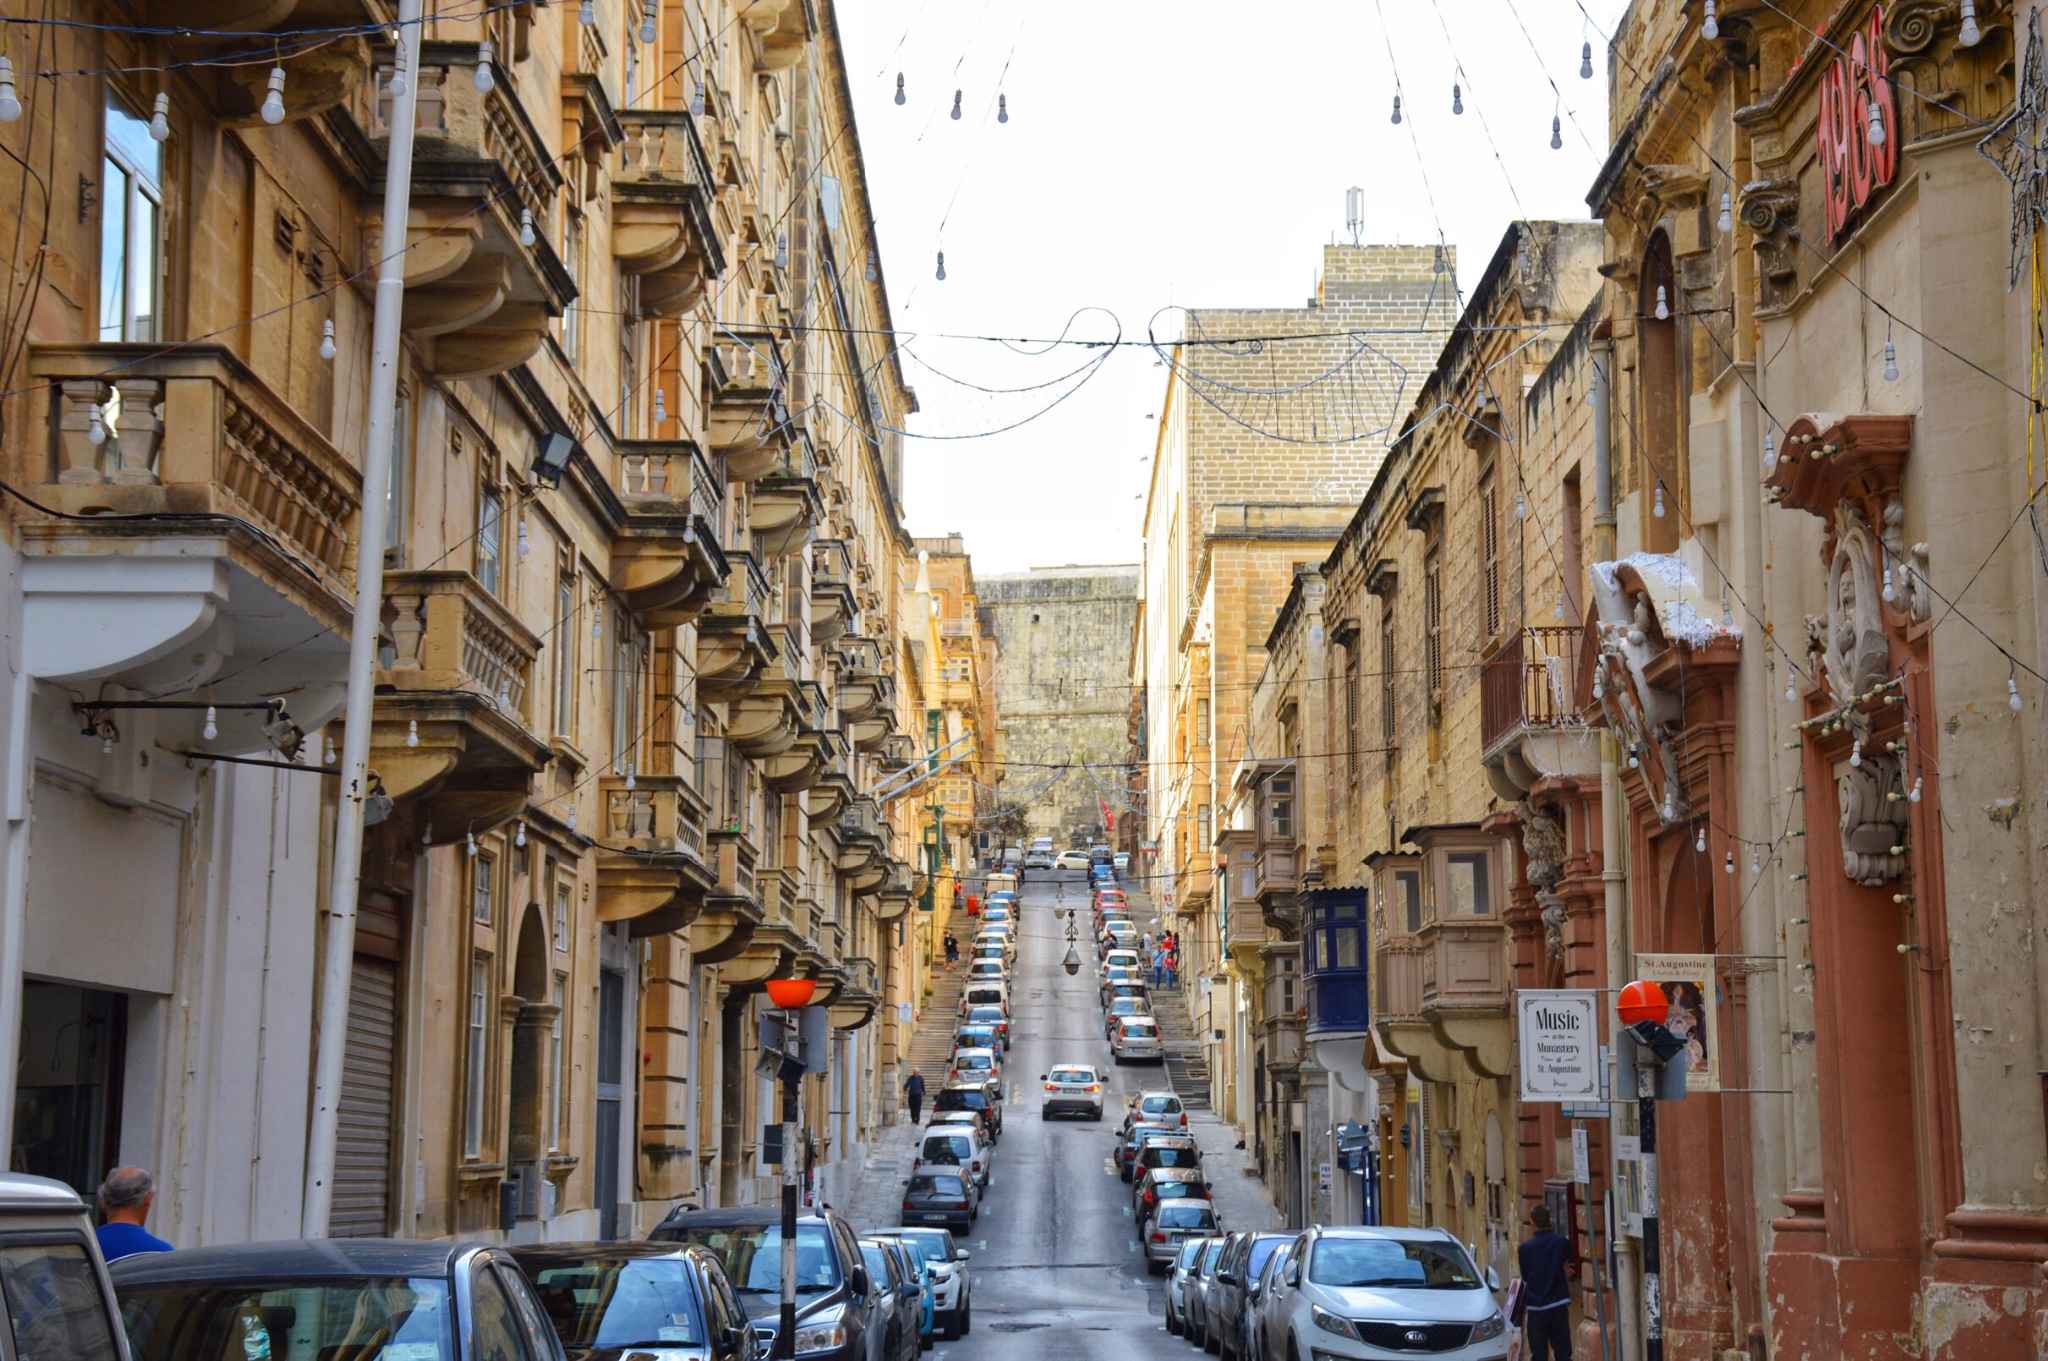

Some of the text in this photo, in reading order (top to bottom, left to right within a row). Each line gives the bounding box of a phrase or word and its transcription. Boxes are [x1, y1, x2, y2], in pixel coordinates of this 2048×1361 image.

[1816, 3, 1895, 246] 1968
[1536, 1007, 1580, 1031] Music
[1536, 1041, 1580, 1055] Monastery
[1548, 1063, 1582, 1075] Augustine
